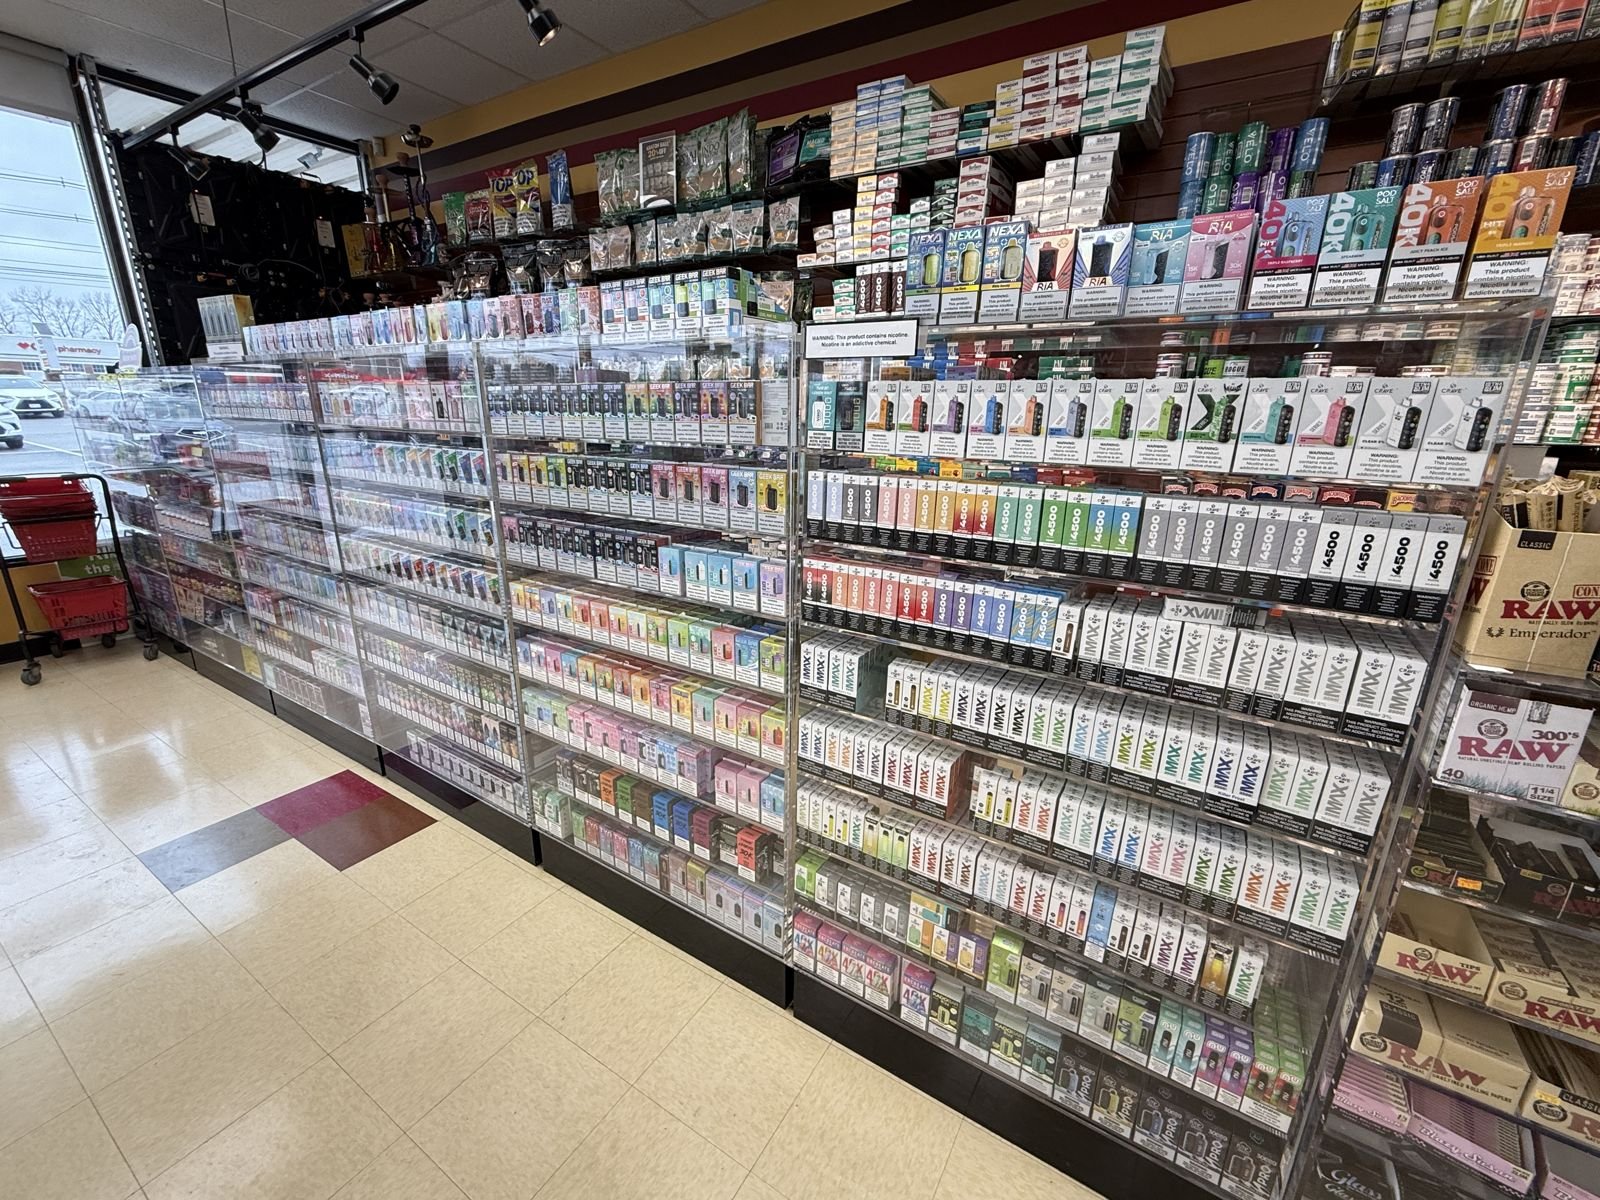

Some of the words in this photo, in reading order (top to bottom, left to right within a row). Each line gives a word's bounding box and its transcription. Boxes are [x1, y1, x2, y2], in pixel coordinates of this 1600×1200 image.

[1134, 29, 1157, 38] Newport
[1030, 55, 1050, 64] Newport
[1062, 48, 1082, 57] Newport
[1095, 58, 1116, 66] Newport
[1030, 73, 1049, 82] Newport
[1028, 108, 1047, 116] Newport
[1056, 119, 1075, 127] Newport
[1244, 130, 1257, 164] VELO
[1300, 127, 1316, 161] VELO
[1185, 143, 1197, 176] VELO
[1223, 141, 1235, 172] VELO
[491, 177, 514, 193] TOP
[1455, 187, 1476, 196] SALT
[1457, 180, 1479, 189] POD
[1375, 197, 1395, 205] SALT
[949, 228, 982, 241] NEXA
[989, 223, 1026, 237] NEXA
[1151, 230, 1173, 241] RIA
[1208, 222, 1233, 233] RIA
[912, 233, 942, 246] NEXA
[1489, 259, 1529, 267] WARNING:
[1501, 266, 1530, 275] product
[649, 277, 661, 285] GEEK
[661, 275, 671, 283] BAR
[675, 273, 688, 281] GEEK
[702, 269, 716, 278] GEEK
[716, 268, 726, 276] BAR
[1088, 277, 1107, 287] RIA
[1418, 272, 1444, 280] product
[1036, 282, 1053, 291] RIA
[1468, 288, 1500, 296] addictive
[1502, 286, 1537, 295] chemical.
[1480, 280, 1509, 288] Nicotine
[1387, 292, 1417, 300] addictive
[1418, 291, 1449, 299] chemical.
[57, 346, 102, 355] pharmacy
[960, 498, 969, 529] 4500
[1000, 501, 1011, 533] 4500
[1047, 505, 1058, 538] 4500
[1070, 508, 1081, 541] 4500
[1201, 519, 1215, 553] 4500
[1230, 522, 1245, 558] 4500
[1520, 541, 1552, 549] CLASSIC
[1291, 528, 1308, 565] 4500
[1322, 531, 1340, 568] 4500
[1357, 534, 1375, 571] 4500
[1391, 537, 1411, 576] 4500
[1428, 540, 1449, 580] 4500
[84, 564, 111, 575] the
[1500, 600, 1600, 620] RAW
[1509, 628, 1591, 640] Emperador
[1323, 663, 1348, 703] IMAX
[1356, 669, 1383, 709] IMAX
[1388, 675, 1415, 716] IMAX
[1470, 701, 1497, 711] ORGANIC
[1499, 706, 1517, 714] HEMP
[1012, 705, 1025, 737] IMAX
[1532, 729, 1579, 741] 300's
[1117, 733, 1134, 765] IMAX
[1457, 736, 1571, 763] RAW
[1165, 744, 1182, 777] IMAX
[920, 767, 930, 796] IMAX
[1214, 756, 1234, 790] IMAX
[1239, 763, 1260, 797] IMAX
[1442, 768, 1465, 779] 40
[1266, 767, 1288, 802] IMAX
[1529, 794, 1555, 802] SIZE
[1101, 827, 1117, 857] IMAX
[1218, 863, 1238, 896] IMAX
[1299, 889, 1320, 923] IMAX
[1327, 896, 1349, 931] IMAX
[1396, 951, 1479, 985] RAW
[1459, 962, 1481, 971] TIPS
[1235, 970, 1255, 1001] IMAX
[1386, 1040, 1487, 1087] RAW
[1402, 1063, 1426, 1075] NATURAL
[1466, 1084, 1490, 1097] ROLLING
[1419, 1125, 1460, 1155] Blazy
